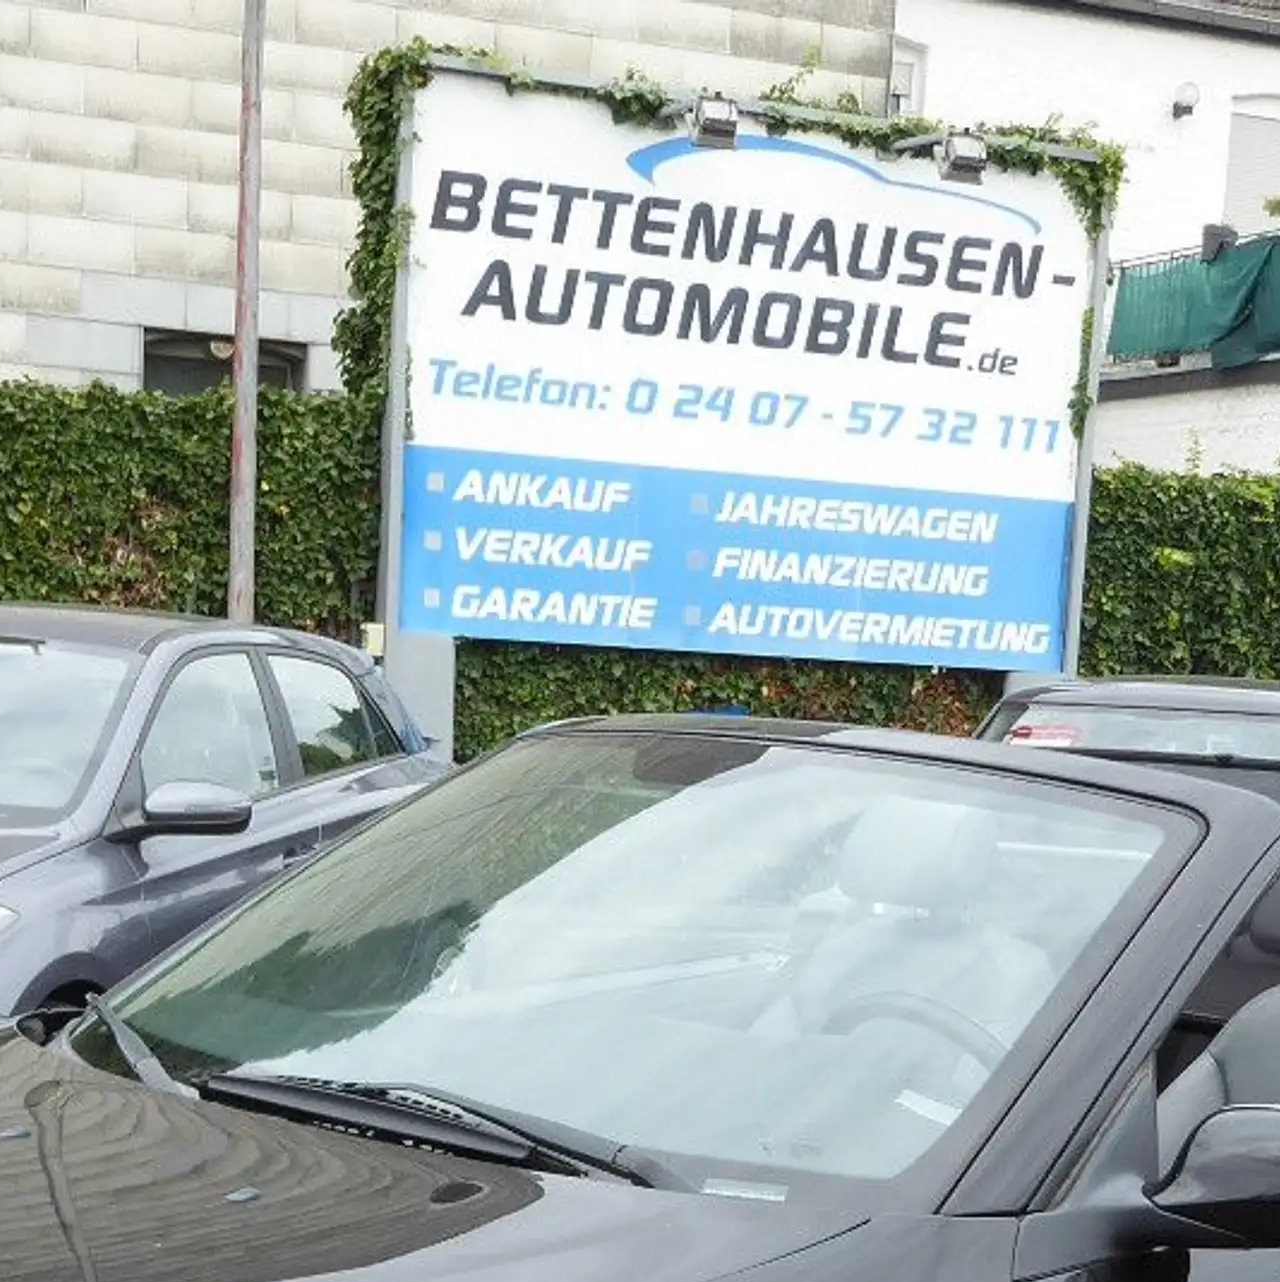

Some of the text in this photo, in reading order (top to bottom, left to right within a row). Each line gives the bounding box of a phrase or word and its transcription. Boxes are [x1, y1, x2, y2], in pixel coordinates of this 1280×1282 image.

[429, 169, 1076, 300] BETTENHAUSEN-
[429, 358, 612, 411] Telefon:
[625, 377, 659, 415] 0
[673, 384, 734, 422] 24
[748, 391, 809, 429] 07
[845, 400, 904, 438] 57
[916, 407, 978, 446] 32
[998, 414, 1061, 453] 111
[452, 468, 632, 513] ANKAUF
[715, 490, 999, 543] JAHRESWAGEN
[455, 526, 654, 572] VERKAUF
[712, 546, 990, 597] FINANZIERUNG
[451, 583, 658, 630] GARANTIE
[708, 602, 1052, 654] AUTOVERMIETUNG
